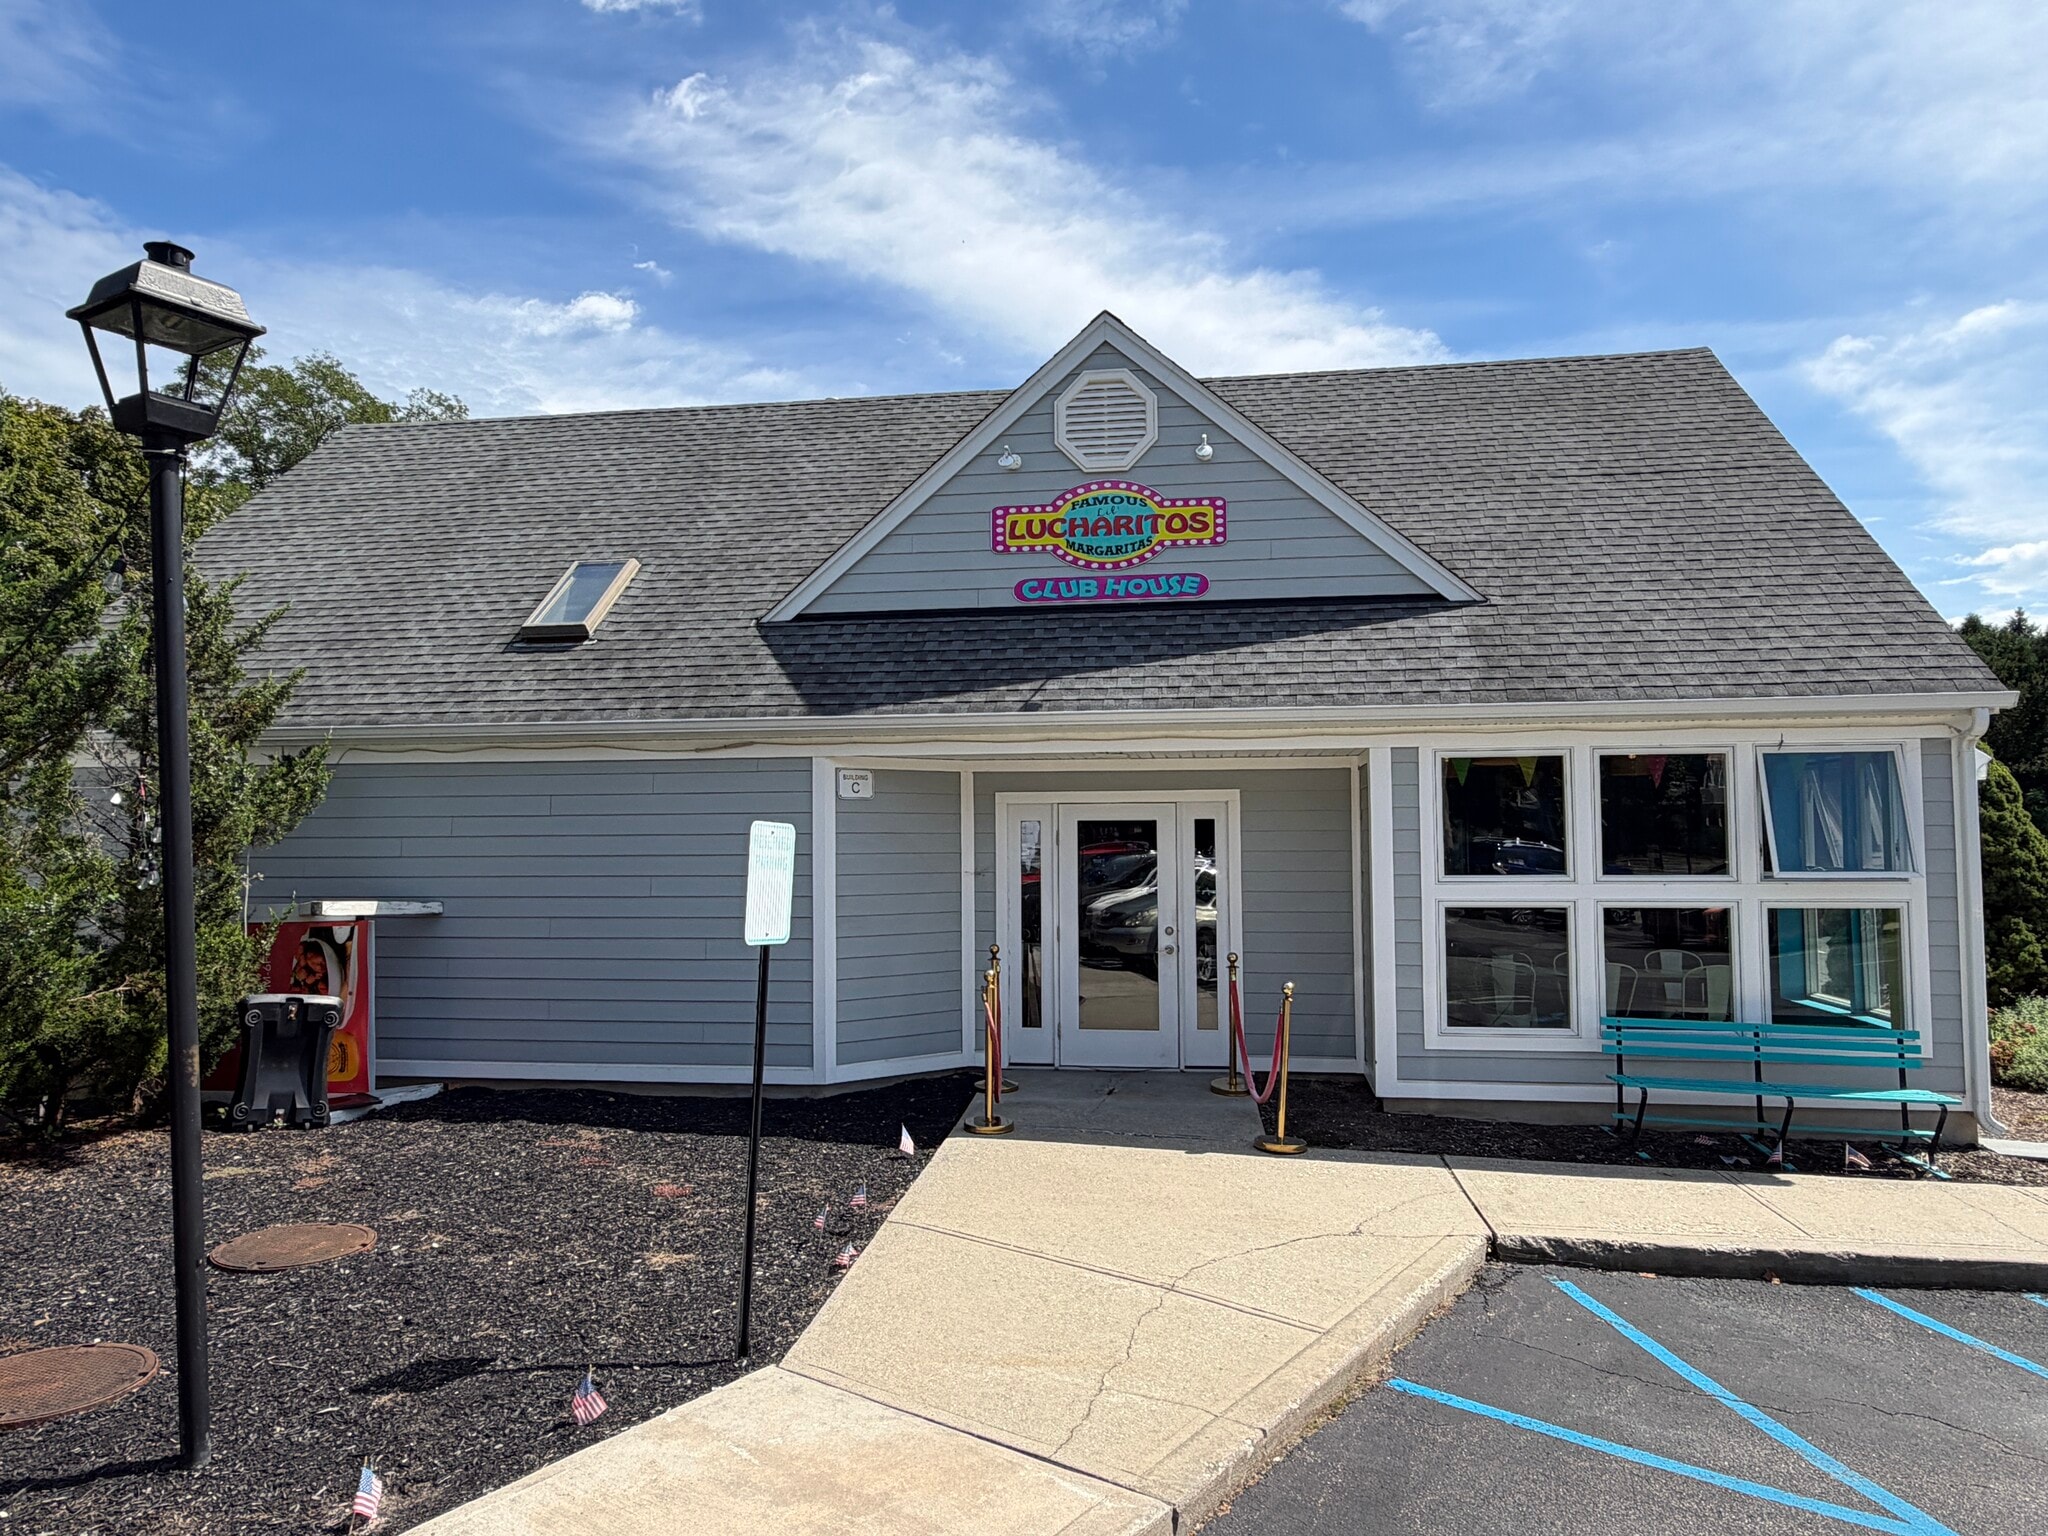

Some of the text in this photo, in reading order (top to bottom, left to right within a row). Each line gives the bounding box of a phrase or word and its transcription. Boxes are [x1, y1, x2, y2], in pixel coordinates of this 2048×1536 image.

[1070, 495, 1148, 511] FAMOUS
[1008, 511, 1210, 540] LUCHARITOS
[1065, 535, 1154, 556] MARGARITAS
[1022, 575, 1200, 599] CLUB HOUSE
[843, 773, 869, 781] BUILDING
[851, 781, 861, 794] C
